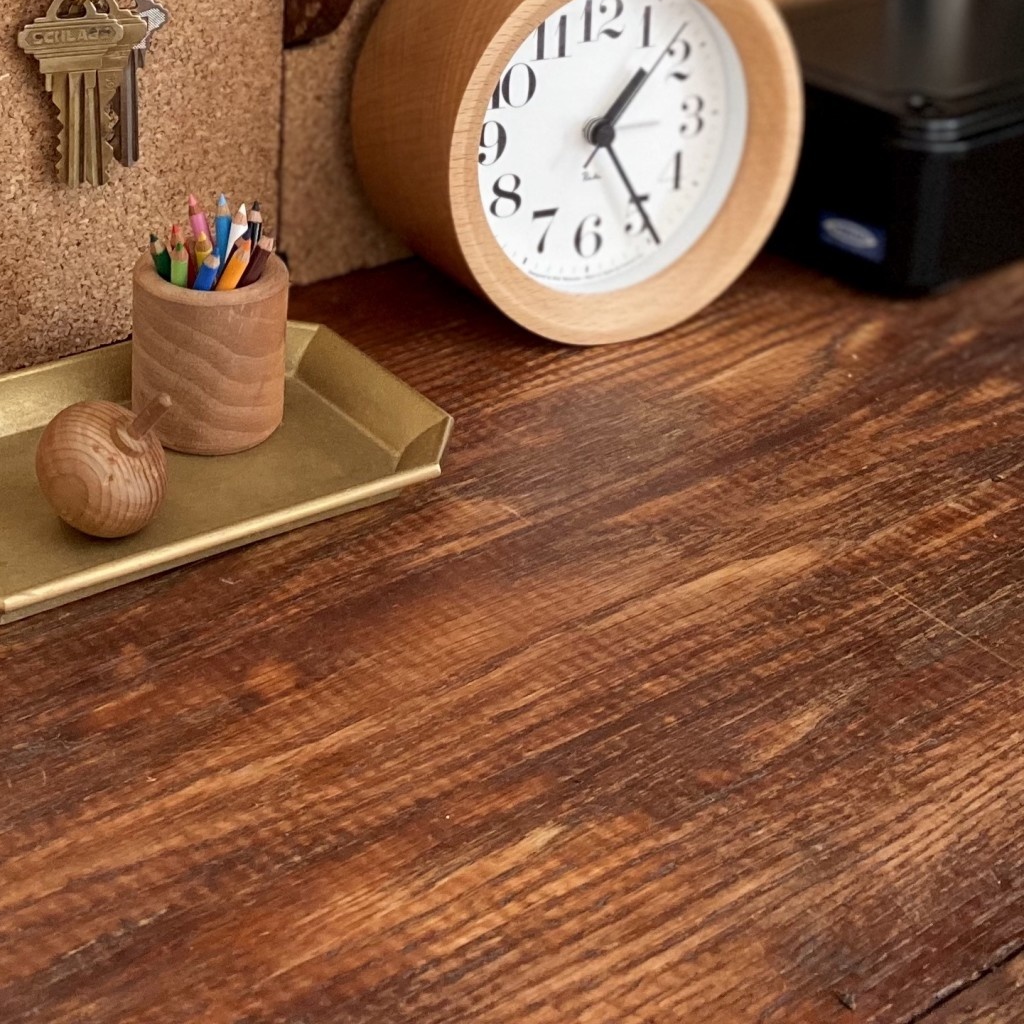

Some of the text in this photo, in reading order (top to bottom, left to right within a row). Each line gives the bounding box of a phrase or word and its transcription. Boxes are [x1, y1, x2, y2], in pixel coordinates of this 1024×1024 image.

[531, 15, 571, 62] 11
[639, 5, 655, 48] 1
[666, 40, 691, 81] 2
[488, 62, 537, 110] 10
[680, 95, 704, 136] 3
[478, 120, 507, 166] 9
[659, 151, 682, 190] 4
[489, 173, 522, 218] 8
[624, 193, 650, 236] 5
[531, 207, 559, 254] 7
[574, 213, 603, 258] 6
